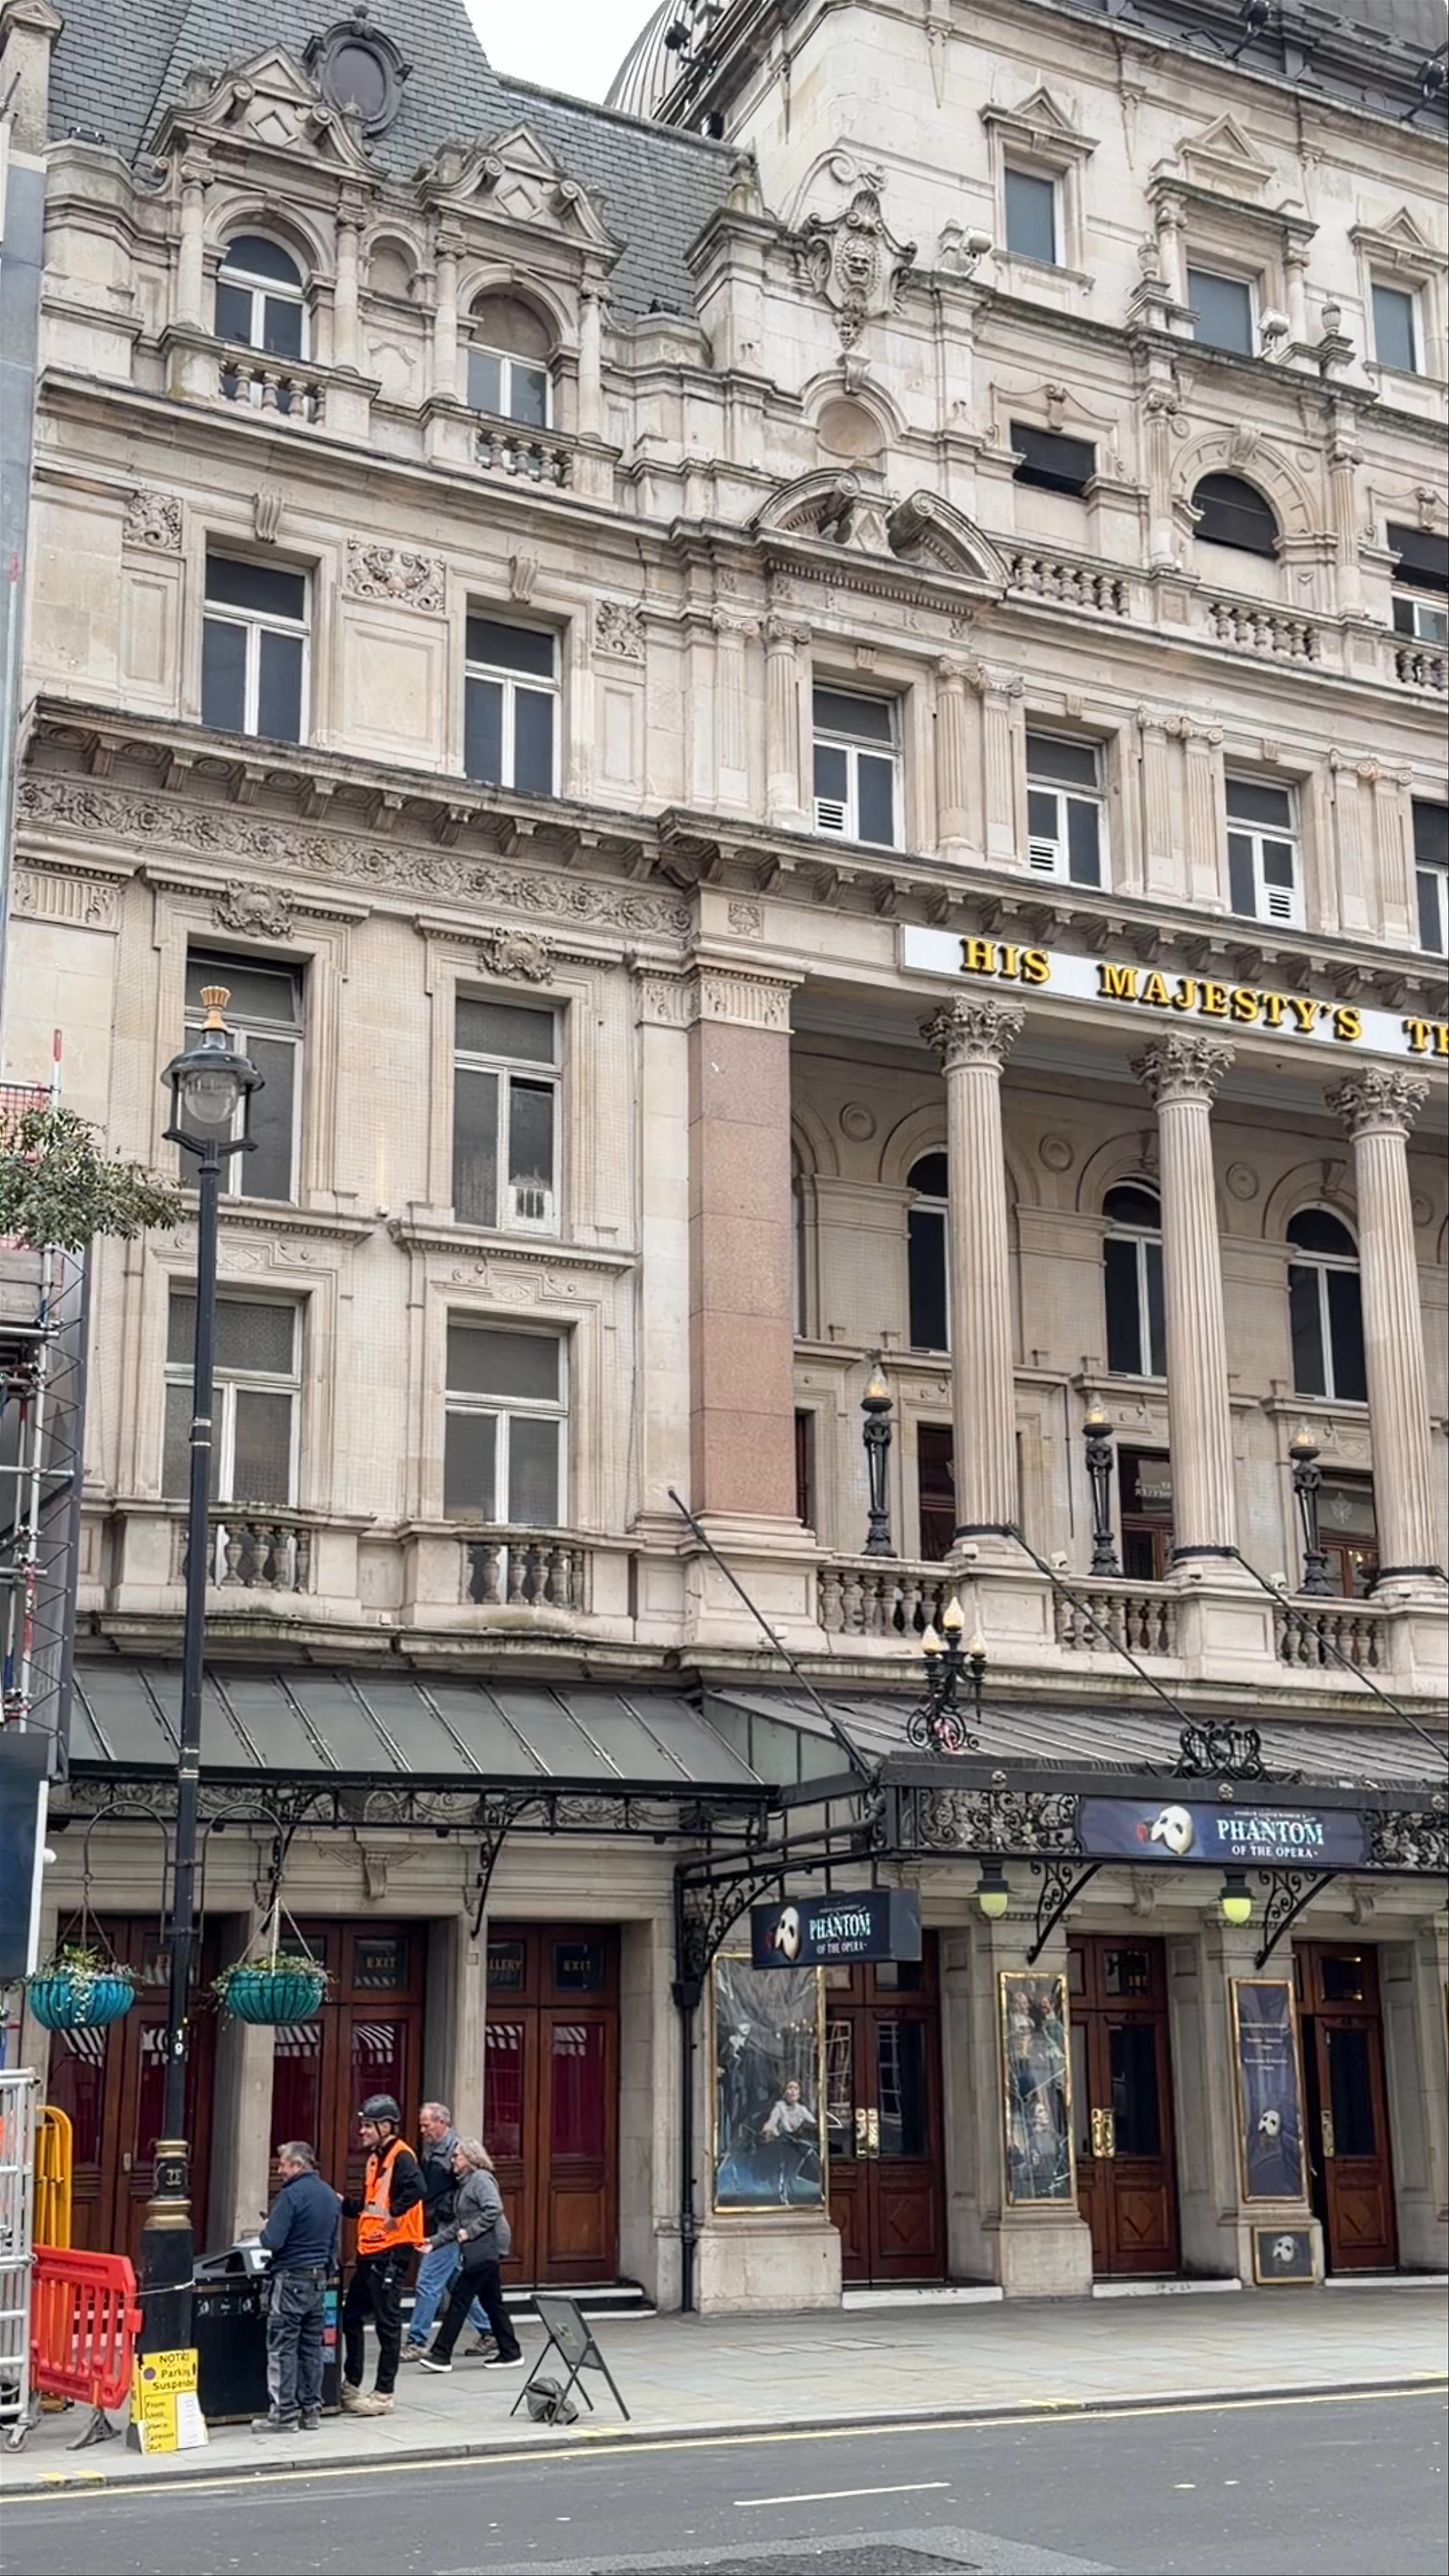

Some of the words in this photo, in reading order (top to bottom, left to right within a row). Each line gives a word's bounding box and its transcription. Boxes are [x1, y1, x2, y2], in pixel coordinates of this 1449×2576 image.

[960, 937, 1050, 984] HIS
[1096, 963, 1361, 1040] MAJESTY'S
[1217, 1819, 1324, 1845] PHANTOM
[1232, 1845, 1246, 1855] OF
[1250, 1845, 1272, 1856] THE
[1275, 1847, 1314, 1858] OPERA
[809, 1912, 871, 1940] PHANTOM
[816, 1944, 826, 1955] OF
[827, 1943, 840, 1953] THE
[367, 1957, 395, 1969] EXIT
[487, 1958, 521, 1970] LLERY
[563, 1960, 590, 1971] EXIT
